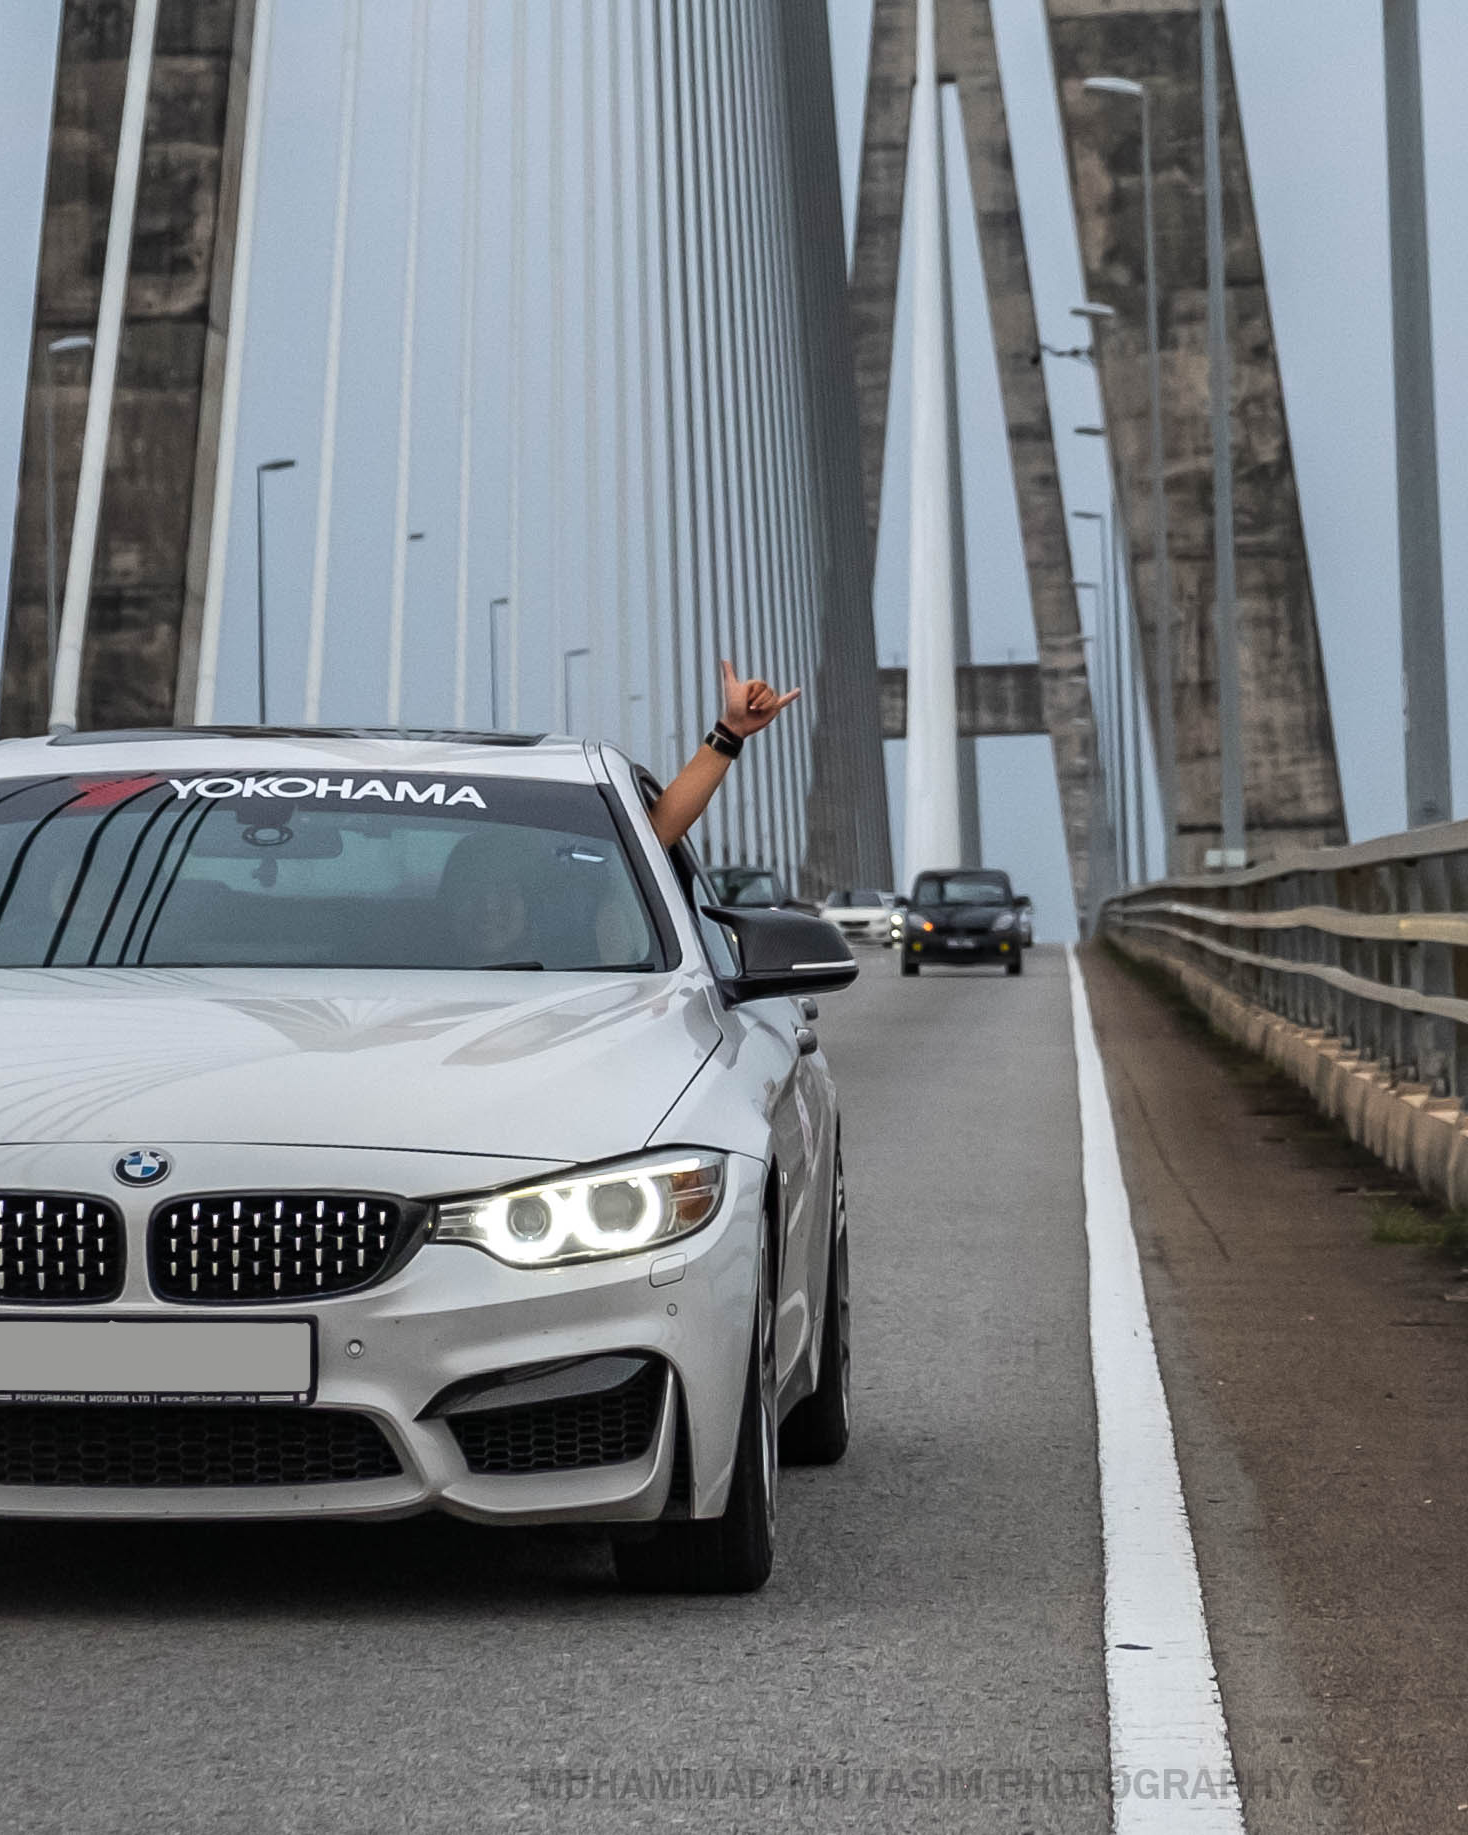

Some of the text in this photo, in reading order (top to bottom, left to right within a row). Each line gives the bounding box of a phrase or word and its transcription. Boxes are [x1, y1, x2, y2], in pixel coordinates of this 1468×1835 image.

[169, 776, 487, 809] YOKOHAMA
[15, 1393, 86, 1403] PERFORMANCE
[89, 1394, 129, 1403] MOTORS
[132, 1394, 150, 1404] LTD
